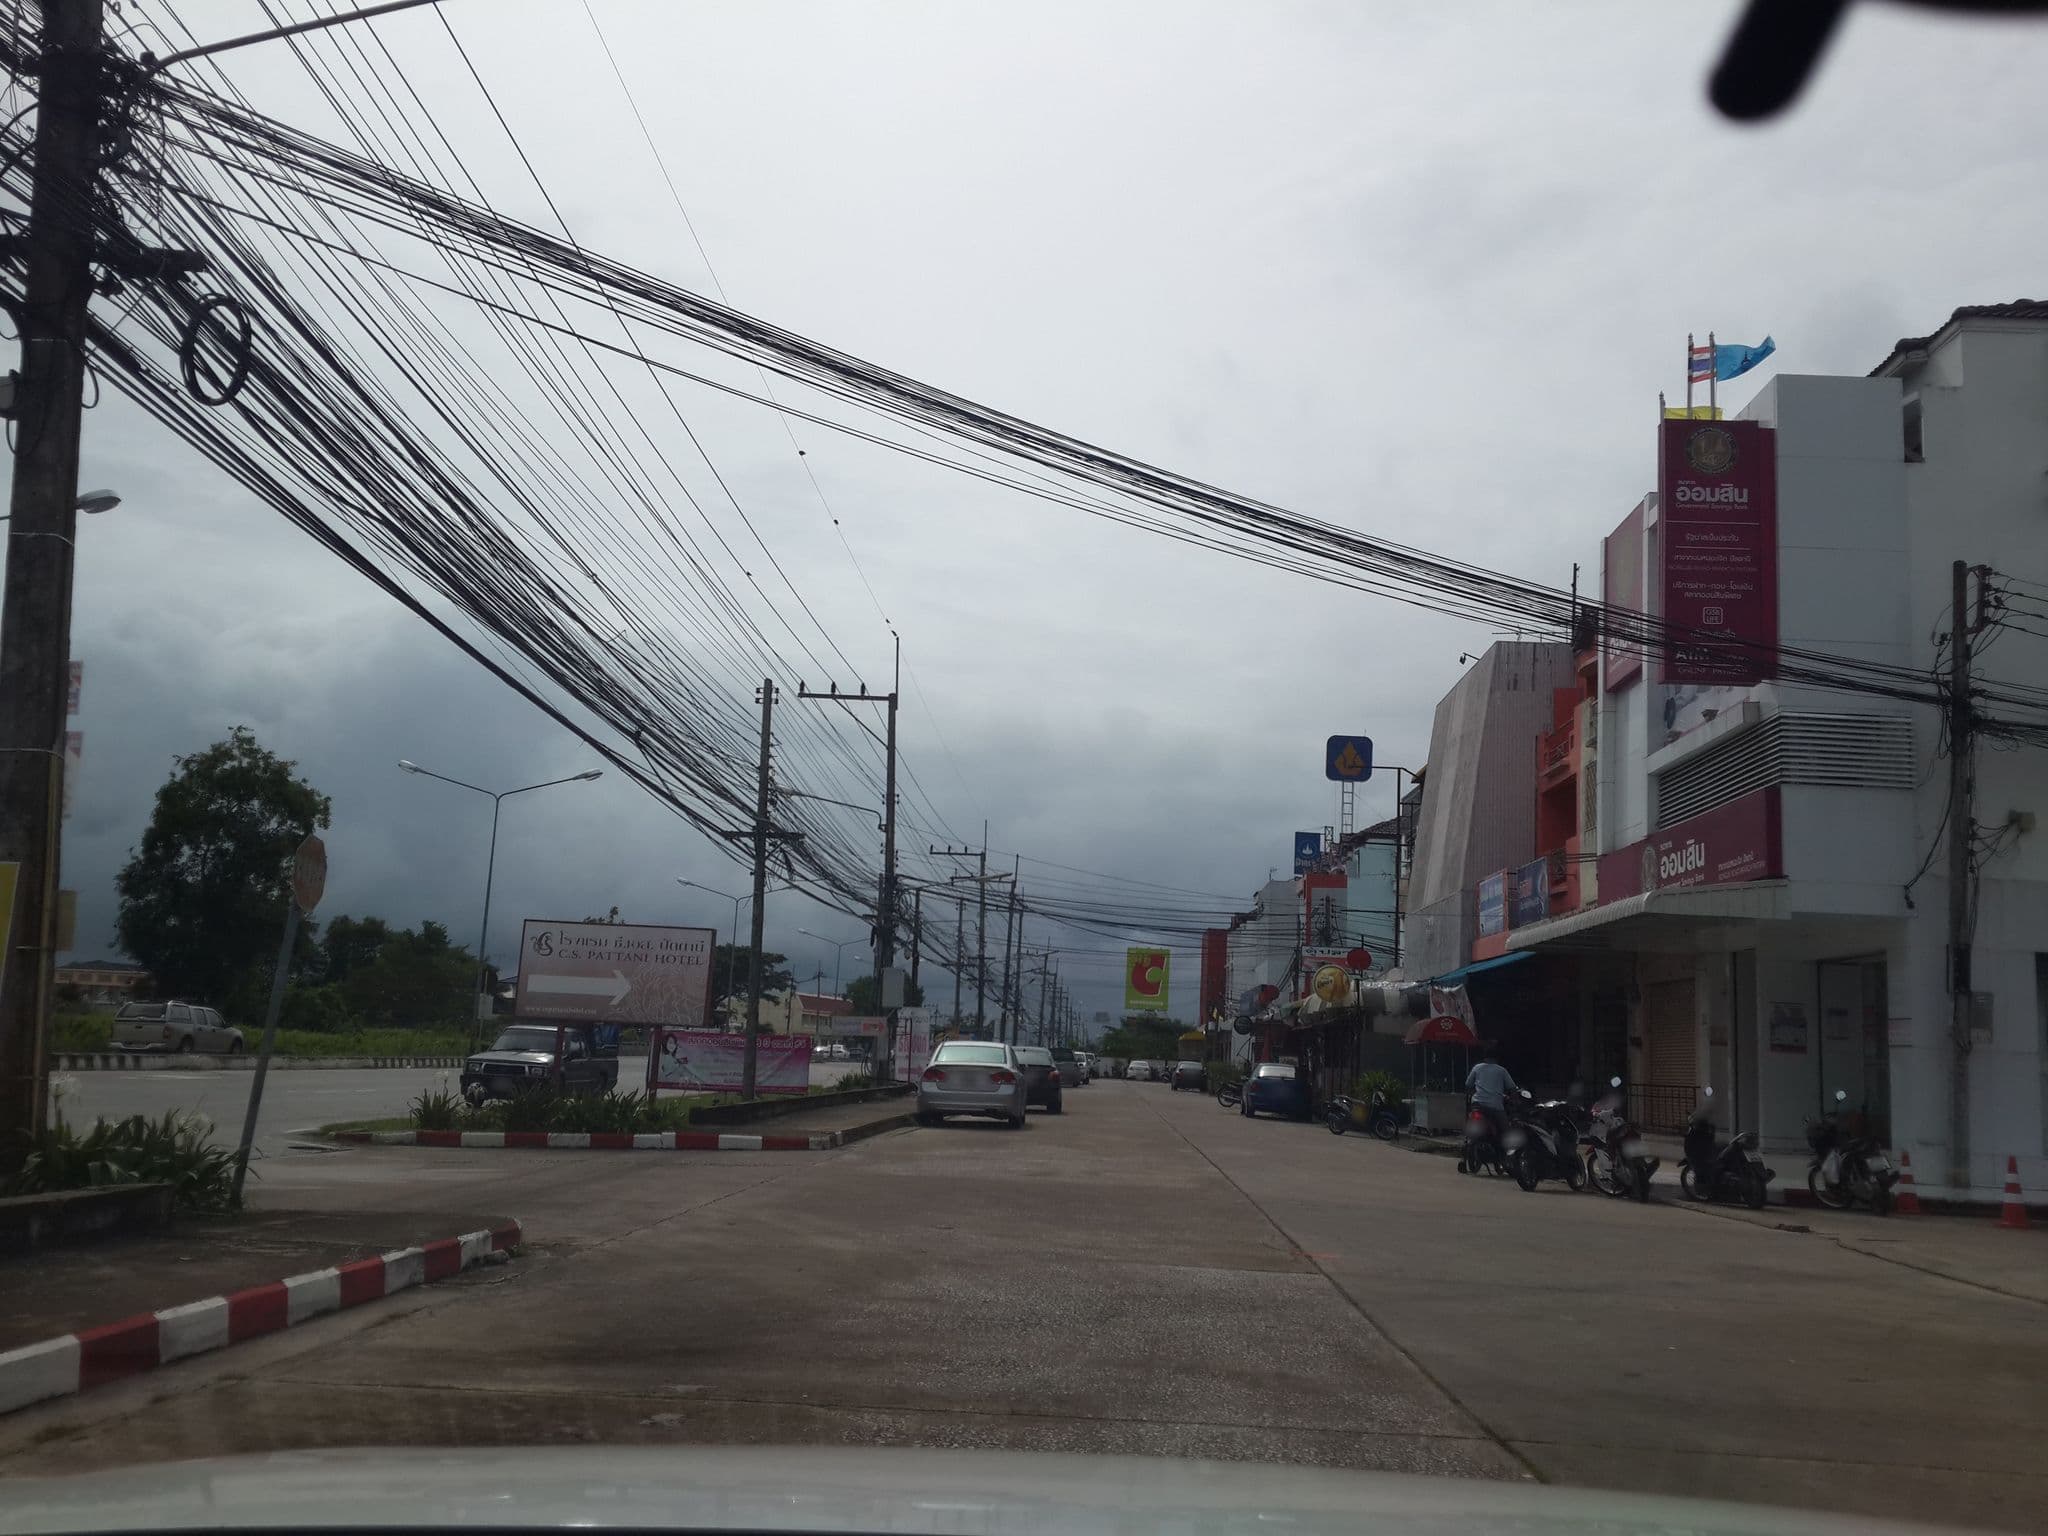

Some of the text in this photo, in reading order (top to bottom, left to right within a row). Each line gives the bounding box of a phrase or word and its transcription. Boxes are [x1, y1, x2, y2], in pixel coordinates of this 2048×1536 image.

[1675, 483, 1749, 504] ออมสิน
[1660, 839, 1705, 879] ออมสิน
[558, 951, 704, 966] C.S. PATTANI HOTEL
